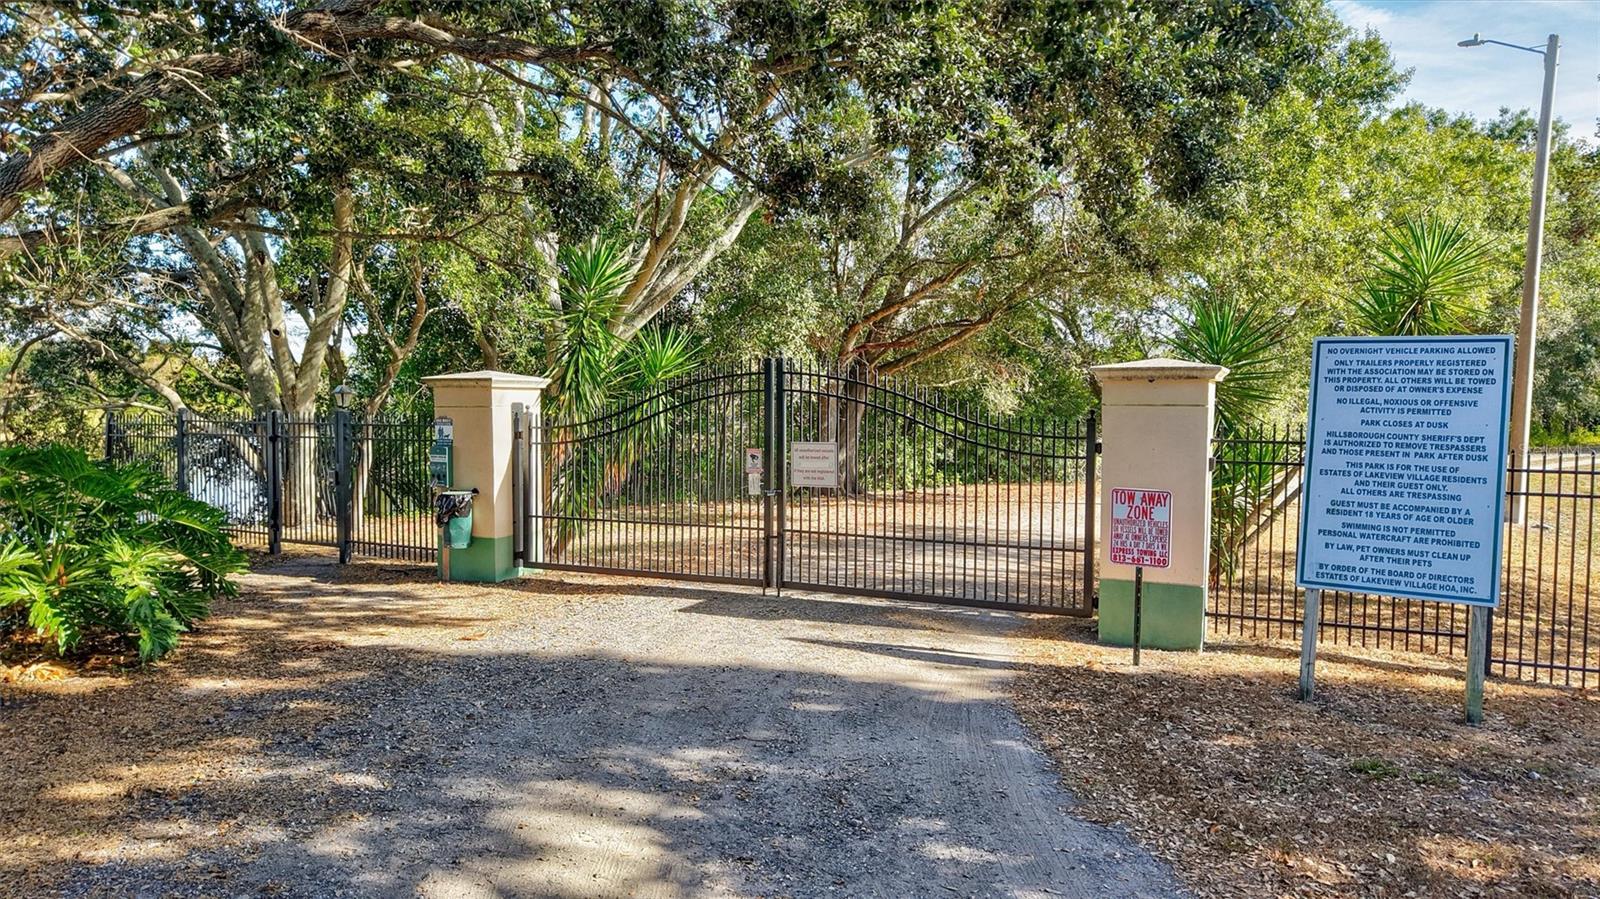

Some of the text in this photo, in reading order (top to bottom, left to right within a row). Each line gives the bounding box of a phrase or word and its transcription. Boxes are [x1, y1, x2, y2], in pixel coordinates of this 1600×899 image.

[1327, 346, 1495, 355] NO OVERNIGHT VEHICLE PARKING ALLOWED
[1334, 359, 1486, 367] ONLY TRAILERS PROPERLY REGISTERED
[1327, 368, 1346, 376] WITH
[1363, 368, 1416, 376] ASSOCIATION
[1417, 368, 1434, 376] MAY
[1435, 368, 1446, 376] BE
[1448, 368, 1480, 376] STORED
[1481, 368, 1494, 376] ON
[1323, 376, 1496, 385] THIS PROPERTY. ALL OTHERS WILL BE TOWED
[1334, 385, 1482, 394] OR DISPOSED OF AT OWNER'S EXPENSE
[1336, 397, 1478, 407] NO ILLEGAL, NOXIOUS OR OFFENSIVE
[1360, 406, 1451, 416] ACTIVITY IS PERMITTED
[1360, 419, 1448, 429] PARK CLOSES AT DUSK
[1326, 430, 1485, 443] HILLSBOROUGH COUNTY SHERIFF'S DEPT
[1323, 439, 1486, 452] IS AUTHORIZED TO REMOVE TRESPASSERS
[1321, 447, 1488, 461] AND THOSE PRESENT IN PARK AFTER DUSK
[1345, 461, 1459, 474] THIS PARK IS FOR THE USE OF
[1319, 468, 1487, 484] ESTATES OF LAKEVIEW VILLAGE RESIDENTS
[1354, 479, 1448, 491] AND THEIR GUEST ONLY.
[1114, 491, 1169, 507] TOW AWAY
[1340, 487, 1461, 501] ALL OTHERS ARE TRESPASSING
[1127, 506, 1155, 520] ZONE
[1330, 499, 1470, 516] GUEST MUST BE ACCOMPANIED BY A
[1326, 507, 1474, 525] RESIDENT 18 YEARS OF AGE OR OLDER
[1341, 521, 1455, 537] SWIMMING IS NOT PERMITTED
[1317, 528, 1480, 548] PERSONAL WATERCRAFT ARE PROHIBITED
[1112, 547, 1135, 555] EXPRESS
[1137, 549, 1157, 557] TOWING
[1324, 542, 1471, 561] BY LAW, PET OWNERS MUST CLEAN UP
[1359, 554, 1432, 567] AFTER THEIR PETS
[1318, 563, 1474, 584] BY ORDER OF THE BOARD OF DIRECTORS
[1315, 571, 1476, 594] ESTATES OF LAKEVIEW VILLAGE HOA, INC.
